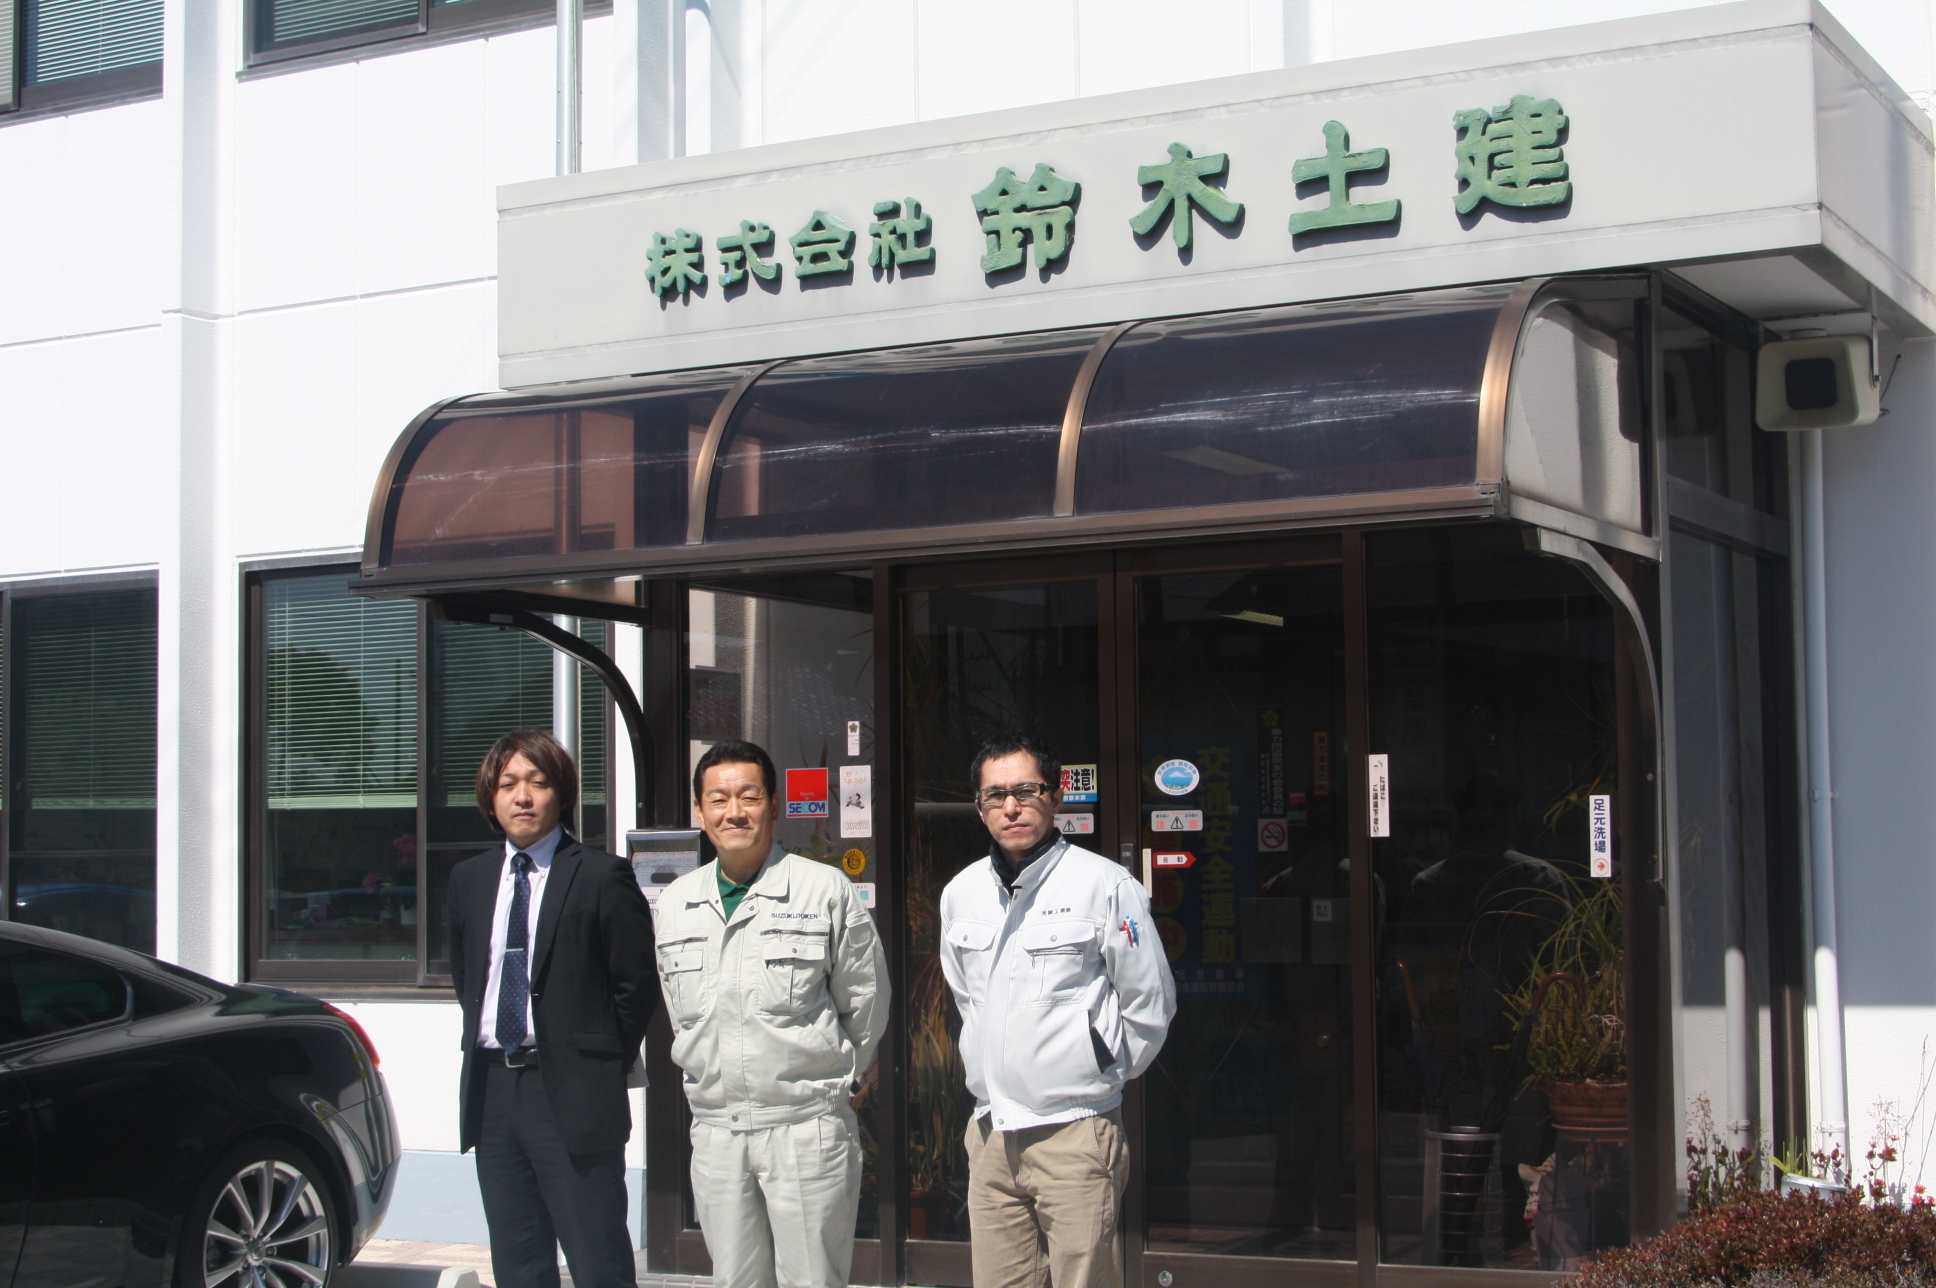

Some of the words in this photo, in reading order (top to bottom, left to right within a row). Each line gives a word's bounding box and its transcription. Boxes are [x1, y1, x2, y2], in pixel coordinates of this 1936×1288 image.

[788, 801, 826, 814] SECOM
[1593, 797, 1607, 854] 足元洗場
[1163, 856, 1183, 864] 自動
[1195, 744, 1237, 964] 交通安全運動
